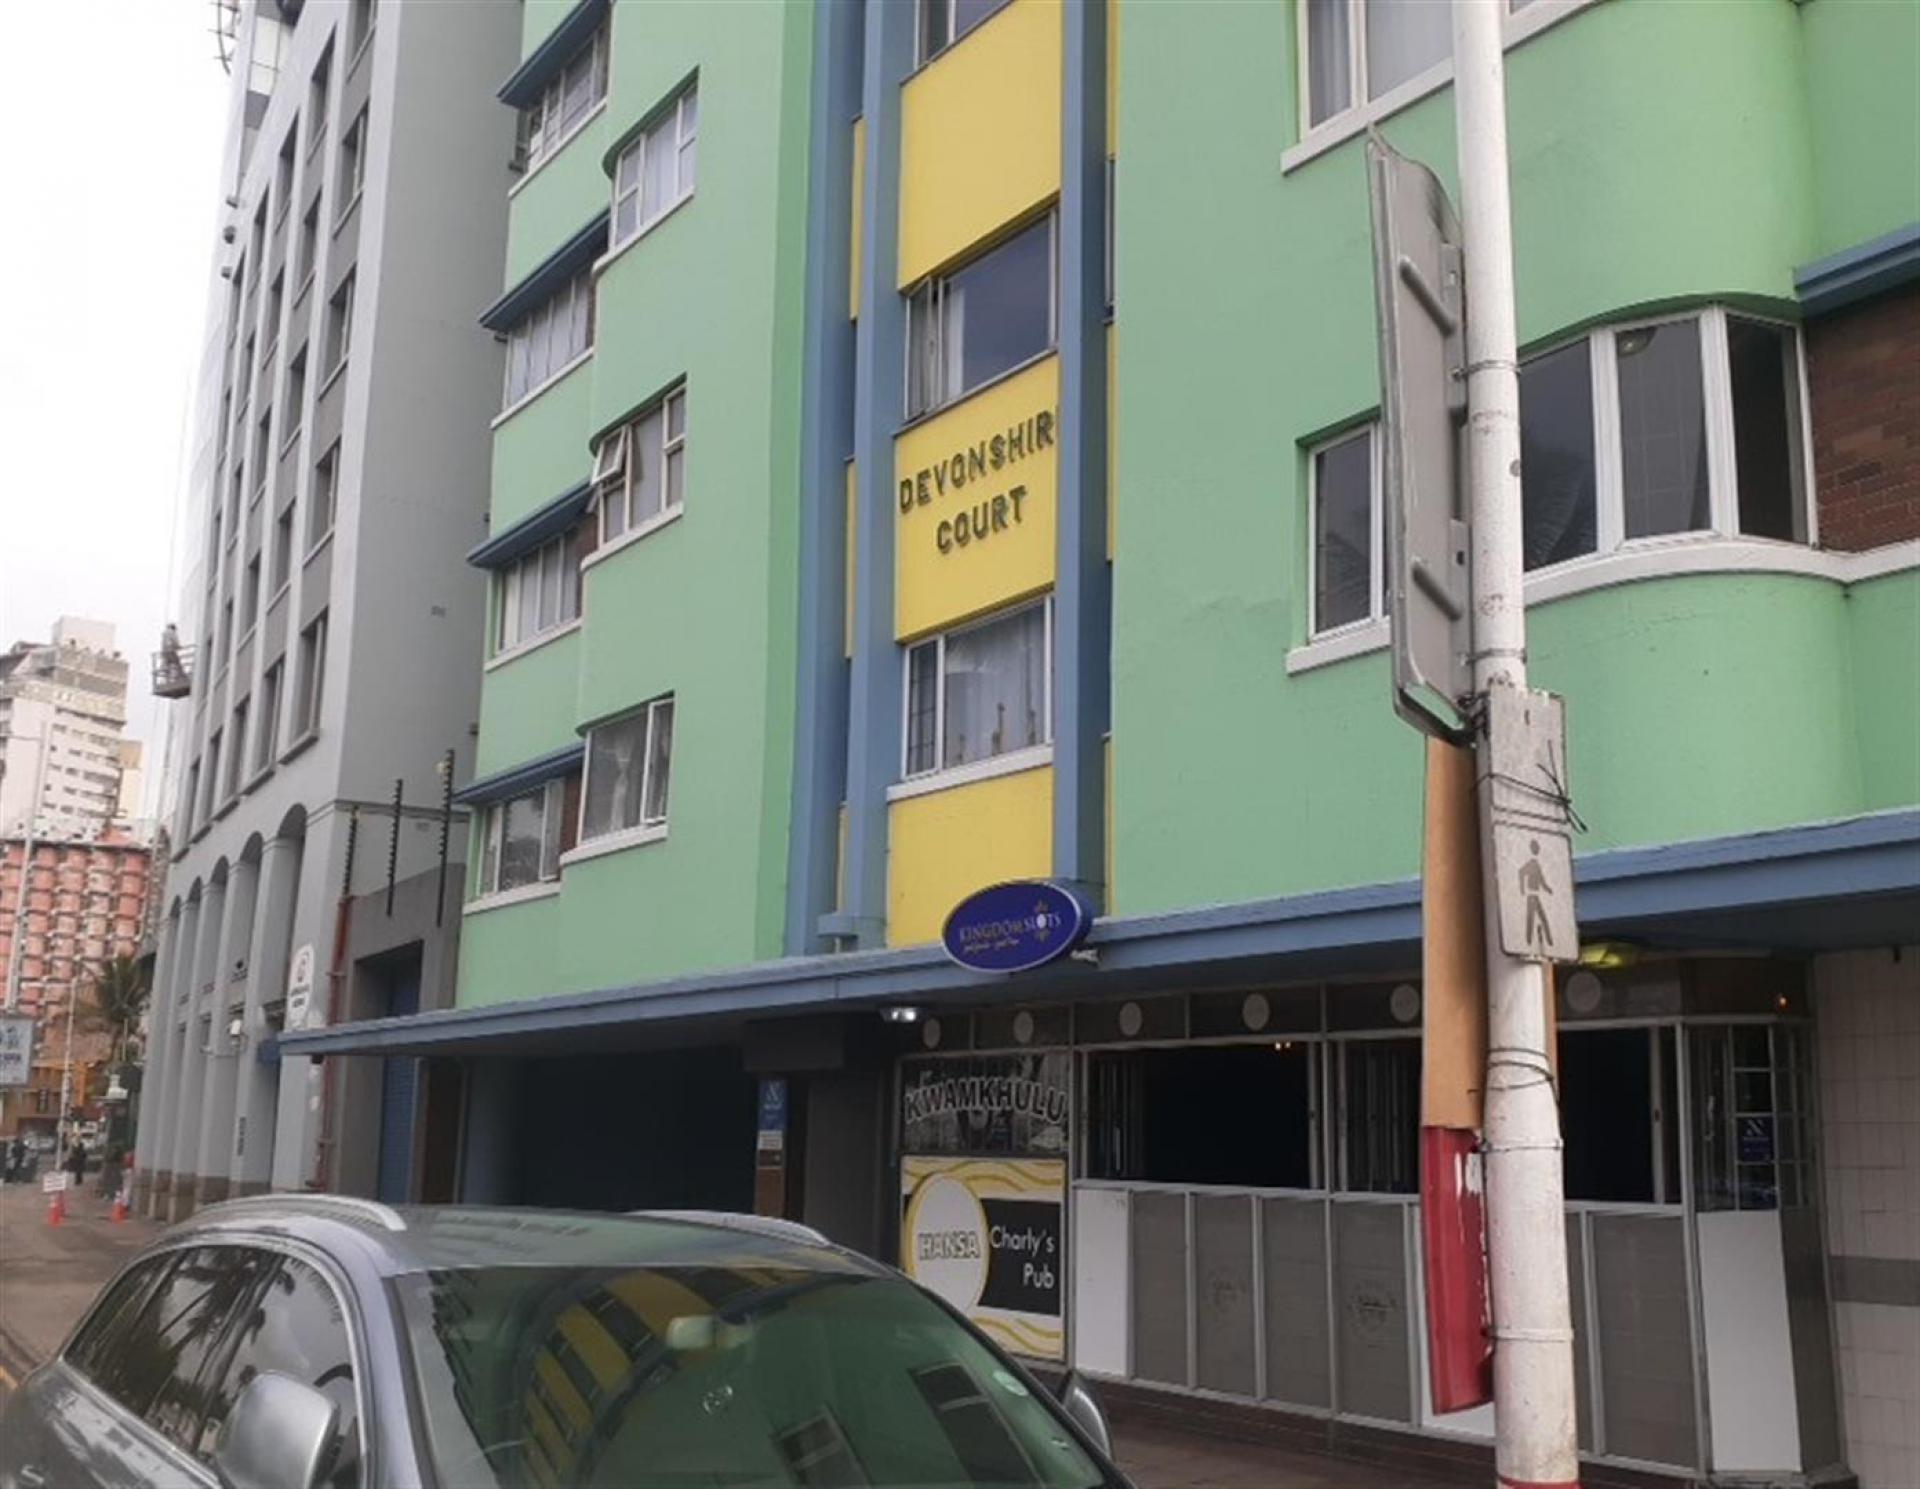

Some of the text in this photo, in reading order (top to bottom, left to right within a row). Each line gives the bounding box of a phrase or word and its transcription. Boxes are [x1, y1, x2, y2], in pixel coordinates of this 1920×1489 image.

[899, 405, 1058, 514] DEVONSHIR
[936, 484, 1027, 555] COURT
[903, 1075, 1067, 1124] KWAMKHULU
[917, 1230, 981, 1261] HANSA
[989, 1225, 1056, 1254] Charly's
[1022, 1265, 1055, 1290] Pub
